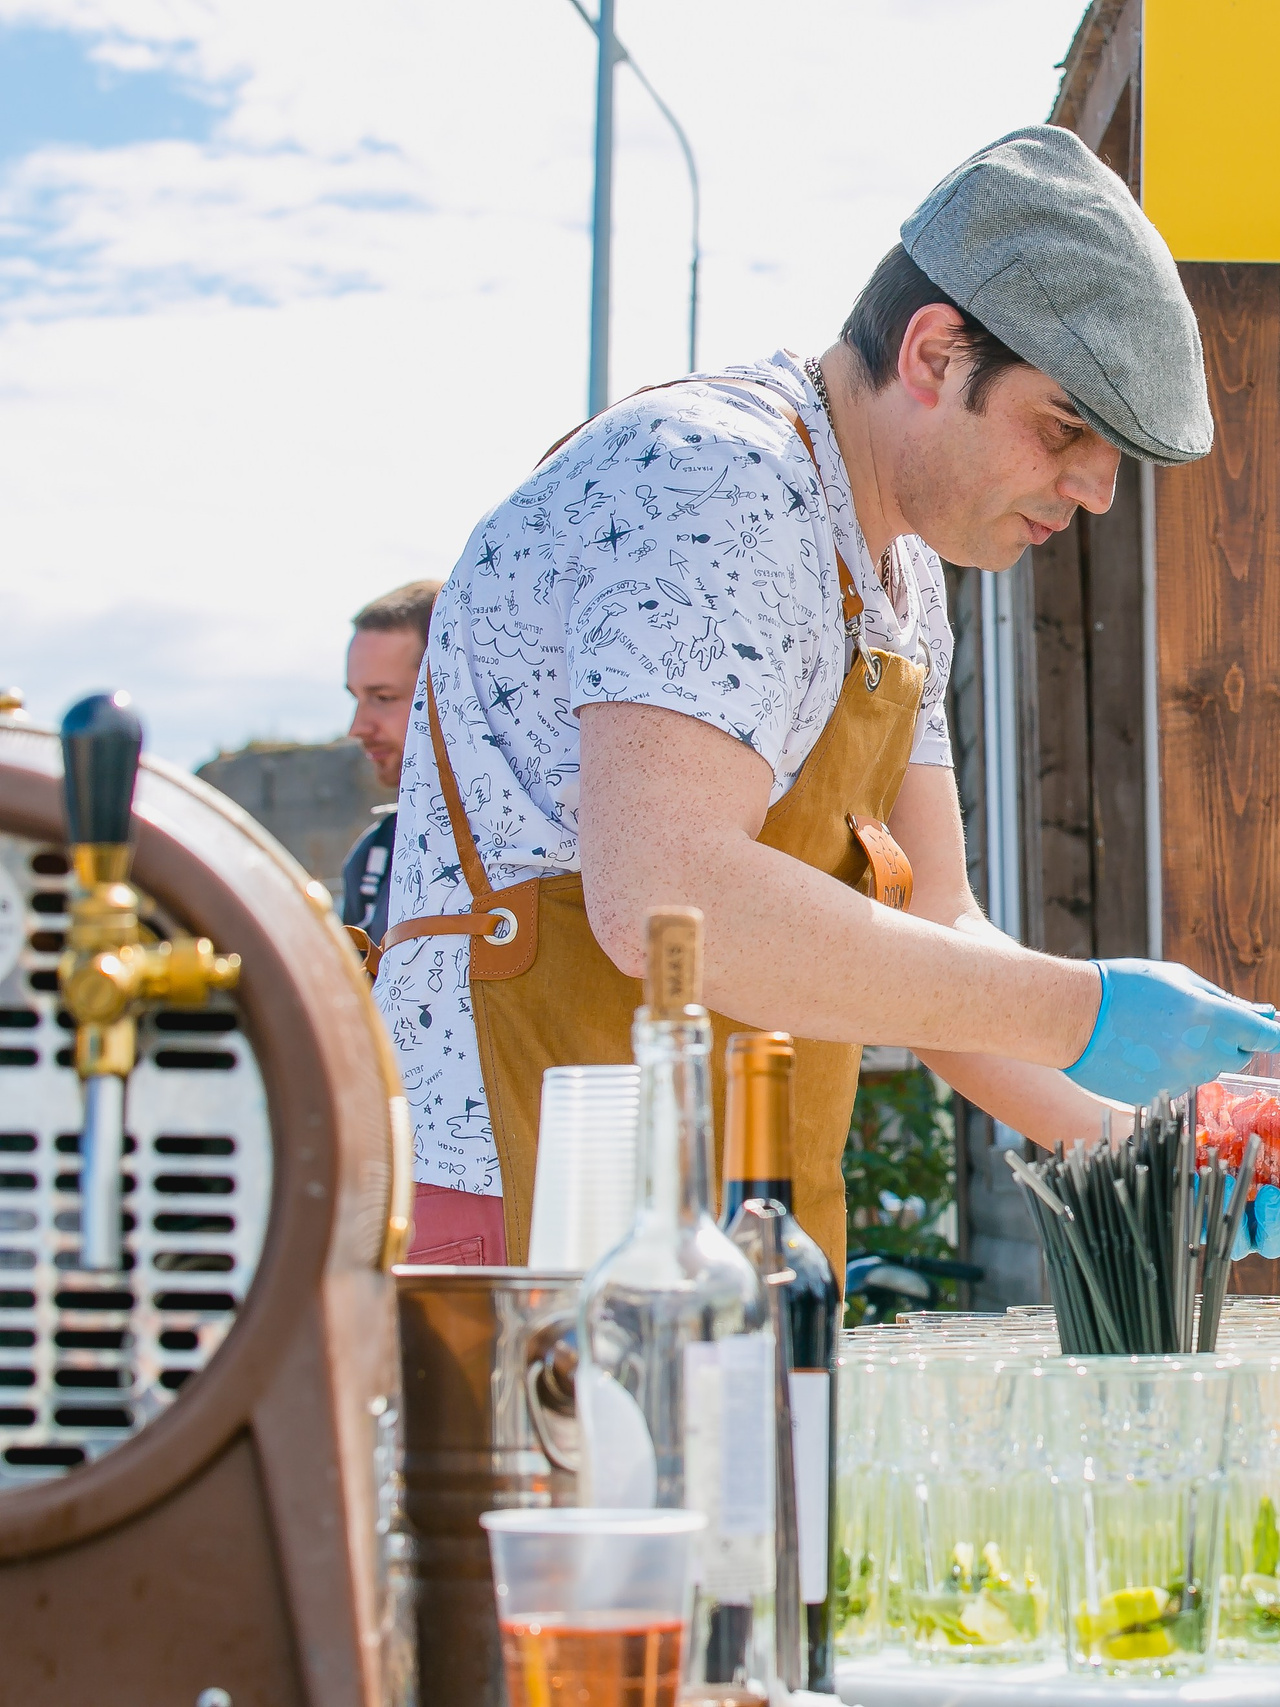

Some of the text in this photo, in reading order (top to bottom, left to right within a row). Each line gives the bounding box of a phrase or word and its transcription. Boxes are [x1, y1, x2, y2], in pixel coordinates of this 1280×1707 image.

[682, 465, 714, 473] PIRATES
[514, 620, 544, 635] JELLYFISH
[540, 645, 565, 654] SHARK
[614, 628, 659, 676] RISING TIDE
[605, 666, 630, 678] PIRANHA
[536, 710, 560, 737] ocean
[425, 1067, 443, 1086] SHARK
[437, 1140, 465, 1155] ocean
